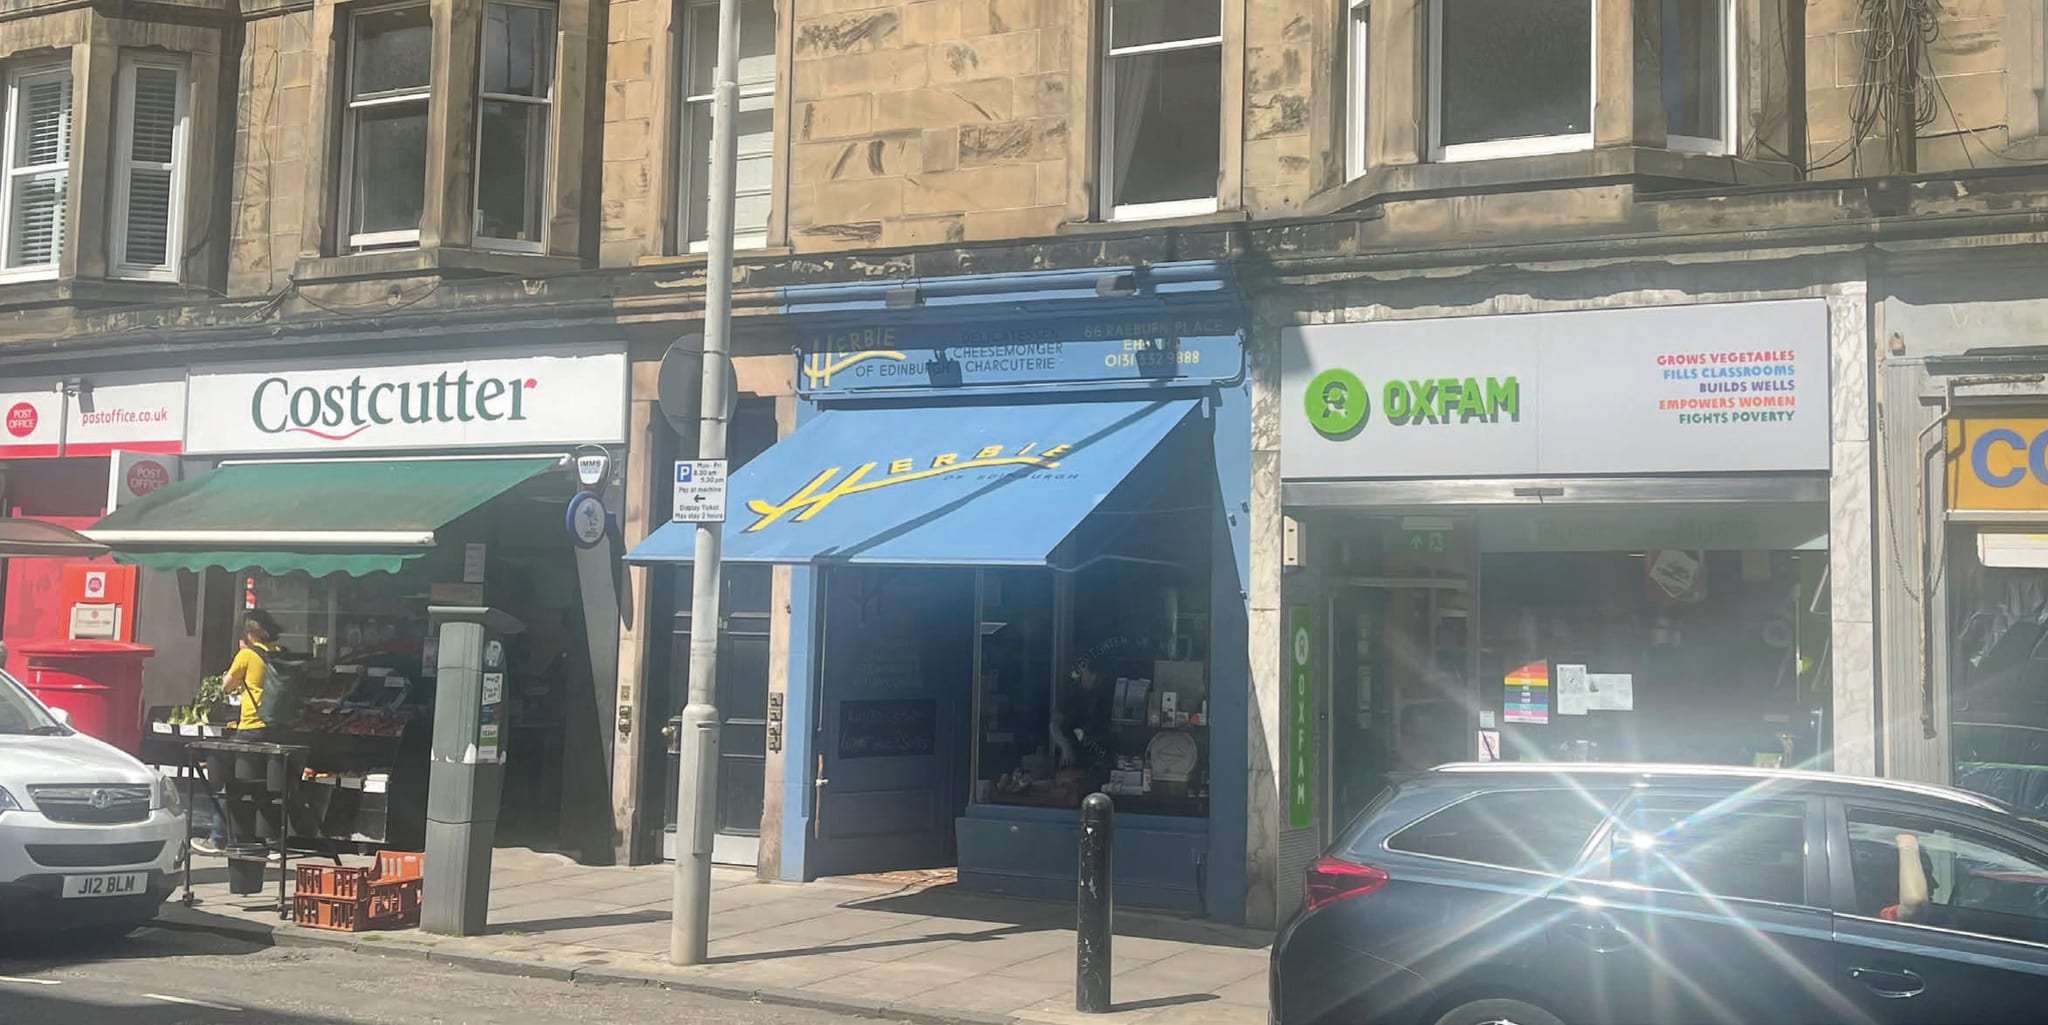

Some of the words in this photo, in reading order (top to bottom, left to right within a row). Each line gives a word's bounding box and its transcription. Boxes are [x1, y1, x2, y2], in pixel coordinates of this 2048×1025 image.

[1175, 319, 1225, 334] PLACE
[803, 326, 908, 390] HERBIE
[952, 342, 1064, 359] CHEESEMONGER
[1166, 350, 1201, 365] 9888
[1656, 353, 1707, 366] GROWS
[1709, 349, 1796, 364] VEGETABLES
[855, 364, 874, 378] OF
[879, 360, 952, 377] EDINBURGH
[964, 357, 1057, 373] CHARCUTERIE
[1663, 367, 1699, 380] FILLS
[1701, 364, 1796, 379] CLASSROOMS
[1699, 381, 1748, 394] BUILDS
[1751, 379, 1796, 392] WELLS
[251, 369, 538, 434] Costcutter
[1382, 375, 1520, 425] OXFAM
[1658, 397, 1736, 410] EMPOWERS
[1738, 395, 1796, 408] WOMEN
[13, 408, 33, 419] POST
[81, 406, 169, 428] postoffice.co.uk
[1678, 413, 1729, 425] FIGHTS
[1731, 410, 1796, 423] POVERTY
[8, 418, 35, 430] OFFICE
[136, 467, 163, 479] POST
[680, 466, 691, 481] P
[740, 442, 1073, 534] HERBIE
[1297, 673, 1305, 806] OXFAM
[78, 877, 103, 894] J12
